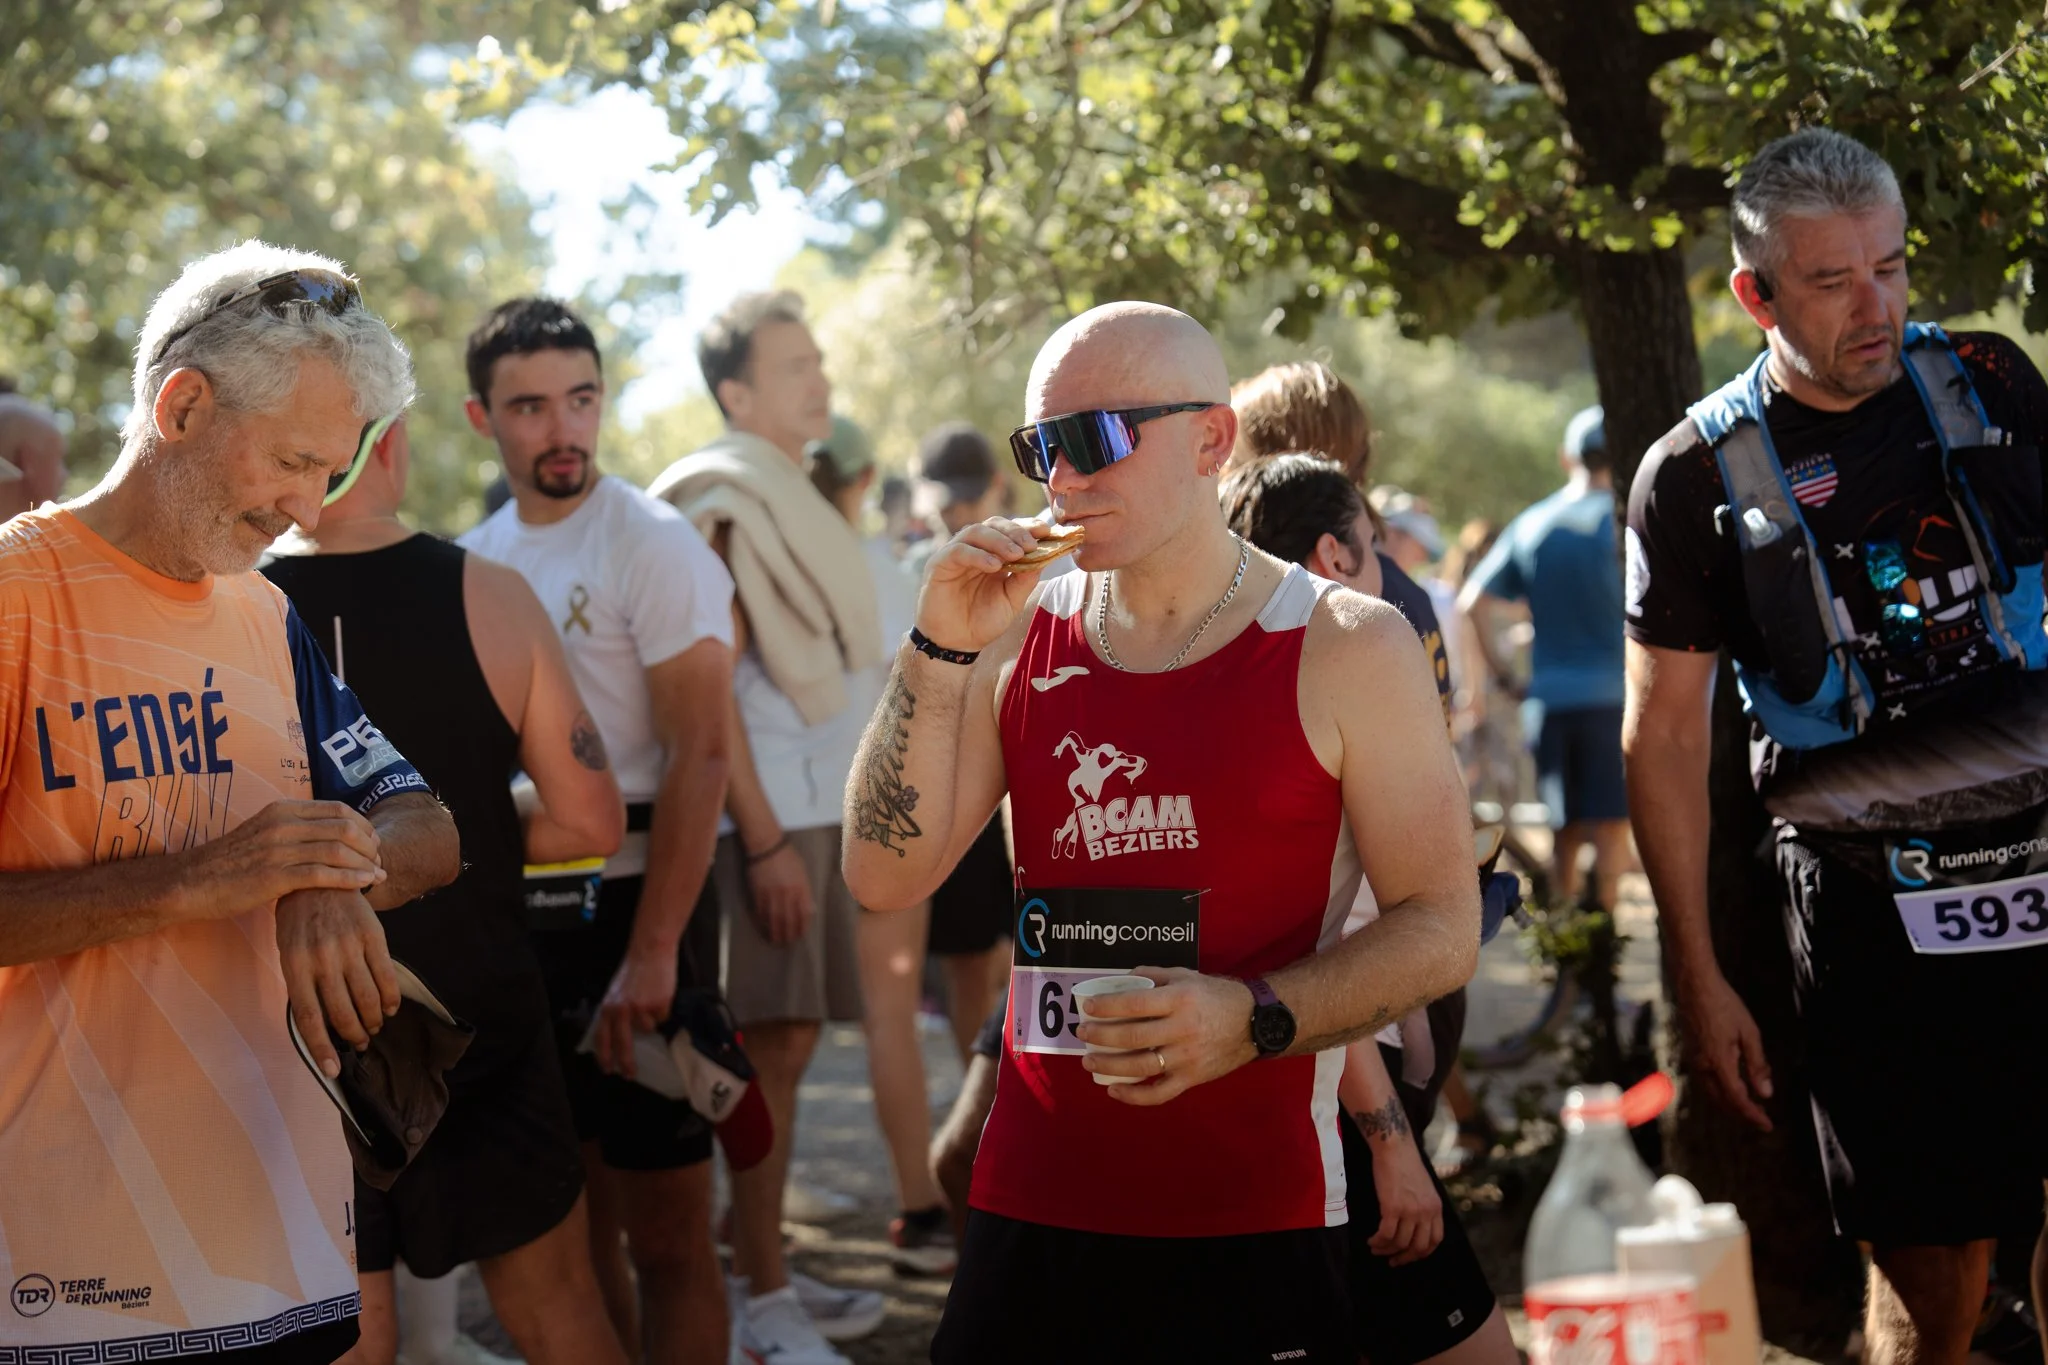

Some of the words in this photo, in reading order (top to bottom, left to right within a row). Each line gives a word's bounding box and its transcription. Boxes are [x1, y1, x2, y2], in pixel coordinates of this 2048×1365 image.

[35, 668, 233, 792] L'ENSÉ
[1076, 795, 1196, 844] BCAM
[1085, 829, 1200, 861] BEZIERS
[1933, 887, 2048, 941] 593
[1051, 920, 1195, 946] runningconseil
[17, 1288, 49, 1304] TDR
[60, 1277, 106, 1293] TERRE
